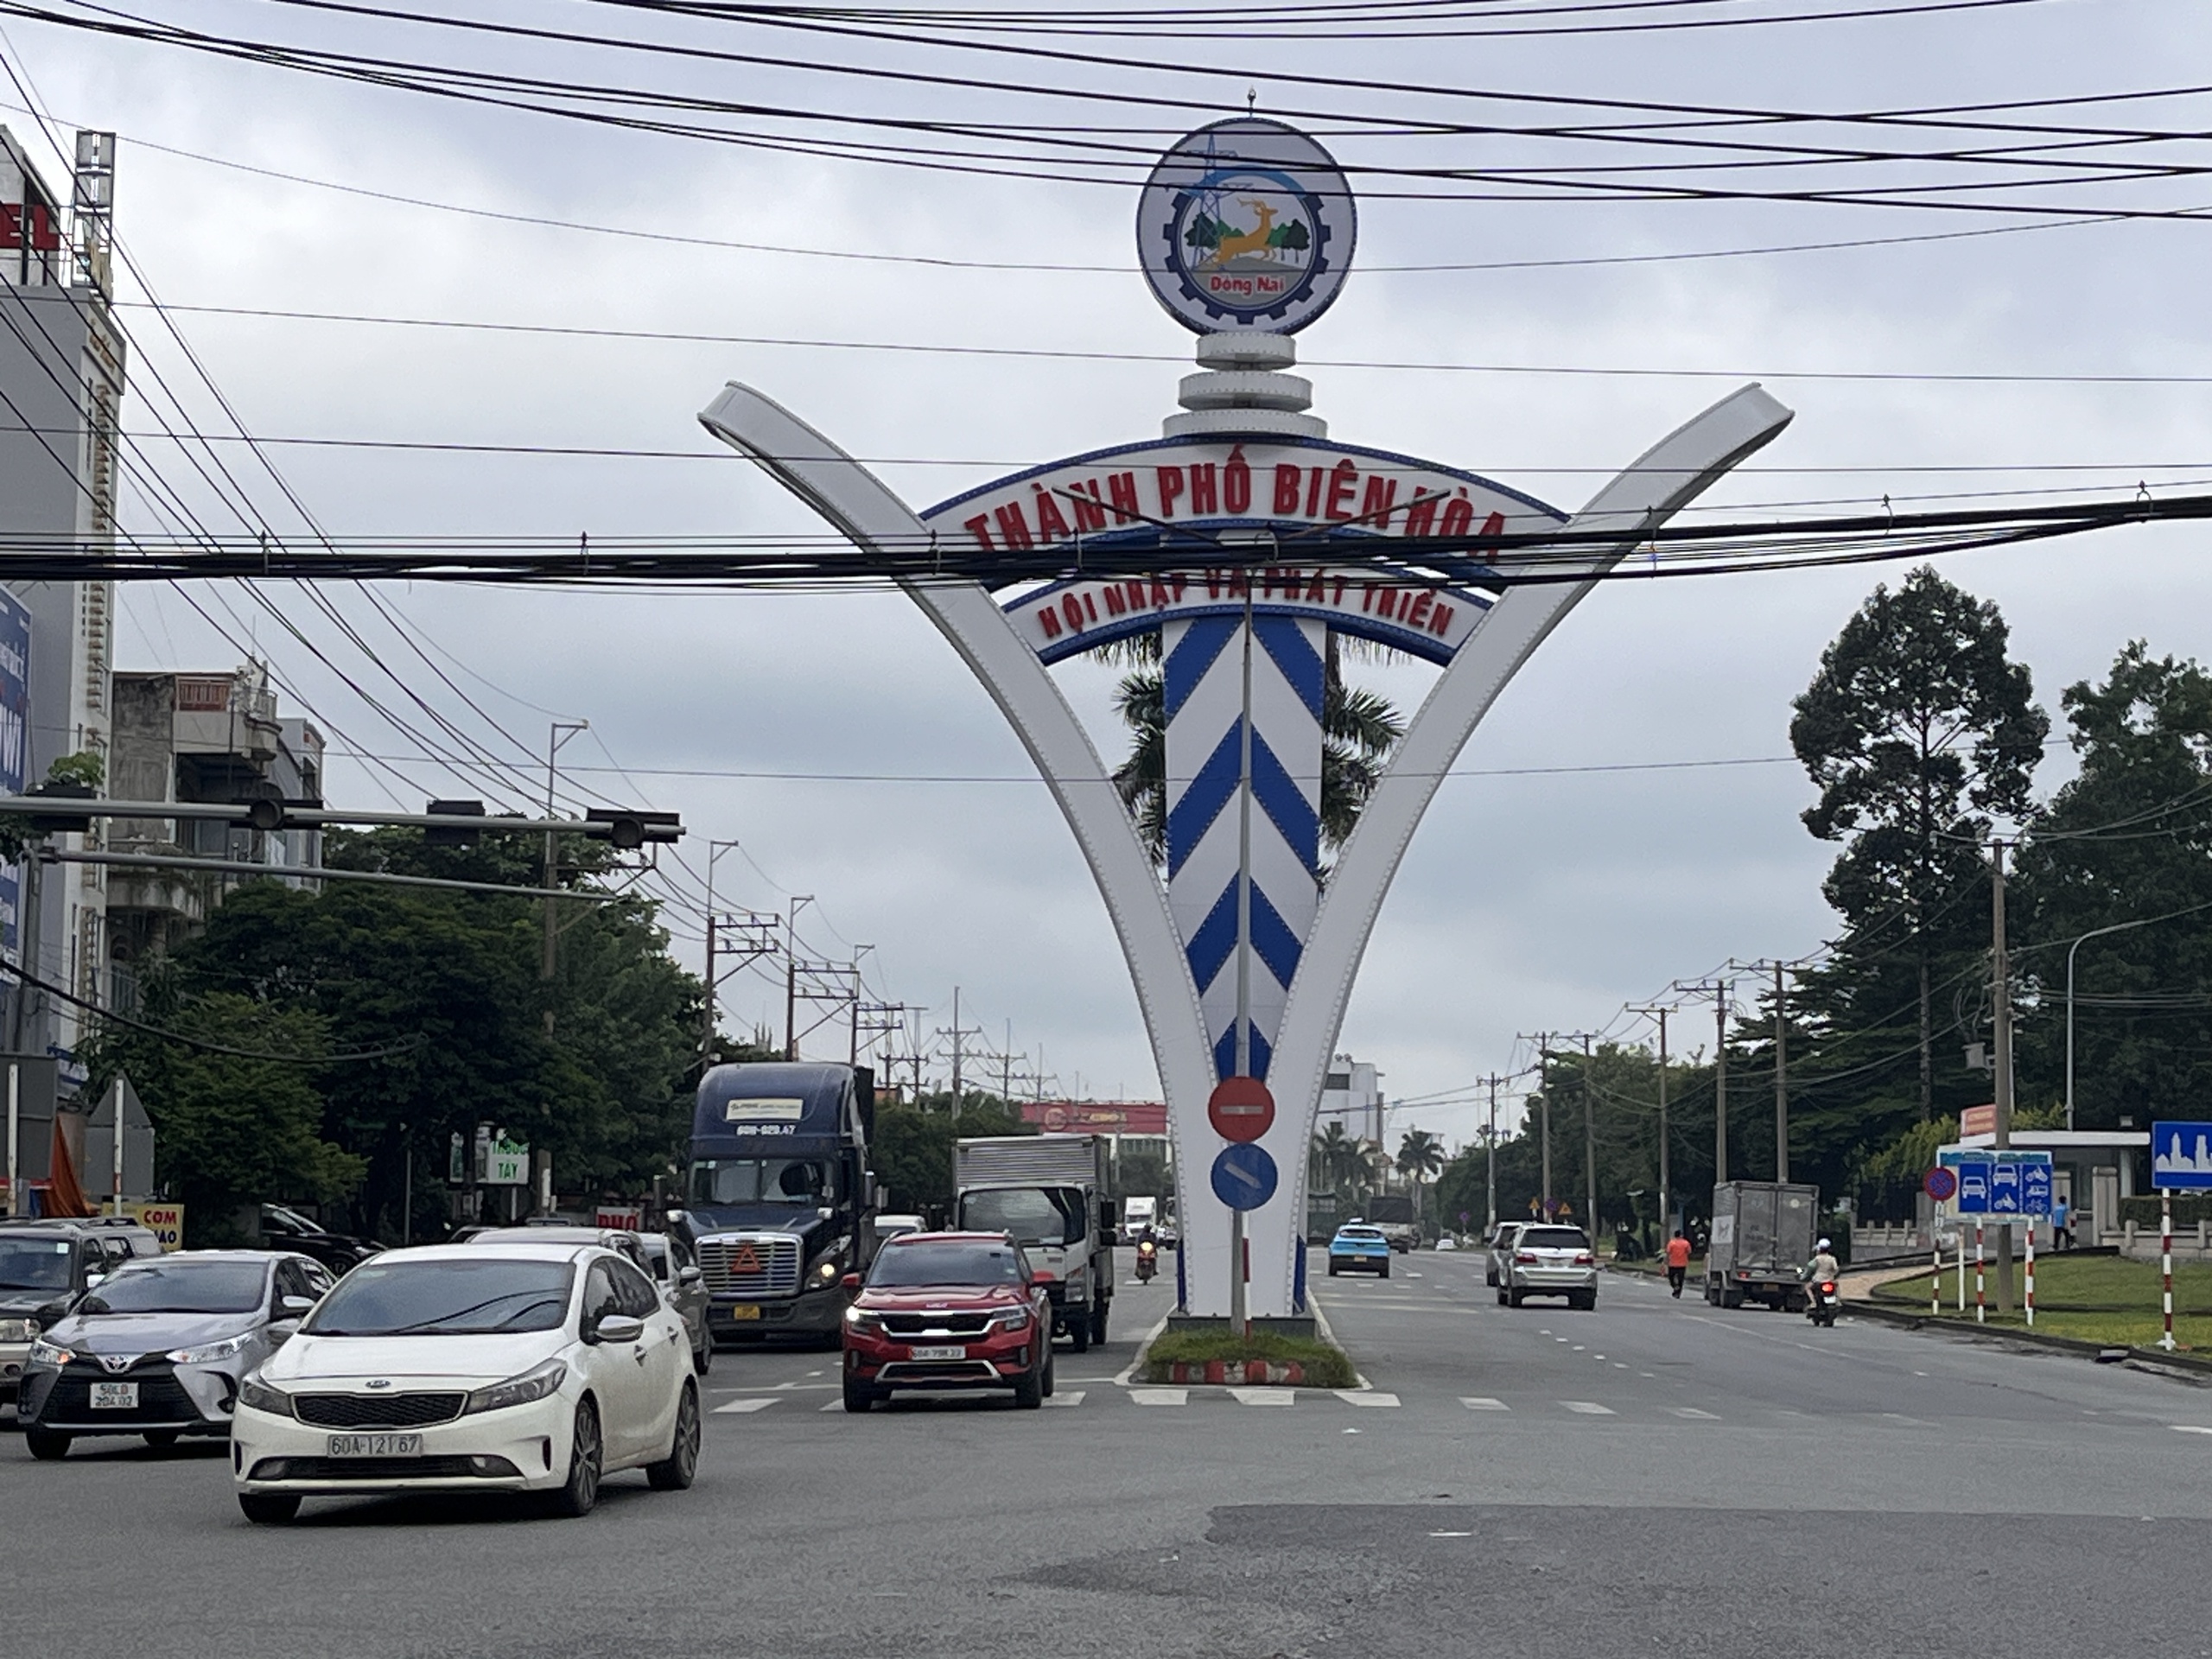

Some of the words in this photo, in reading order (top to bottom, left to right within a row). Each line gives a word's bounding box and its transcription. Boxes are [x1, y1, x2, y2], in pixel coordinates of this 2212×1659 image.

[1257, 276, 1284, 291] Nai
[964, 472, 1140, 552] THÀNH
[1157, 442, 1250, 517] PHỐ
[1274, 458, 1396, 529] BIÊN
[1404, 486, 1505, 563] HÒA
